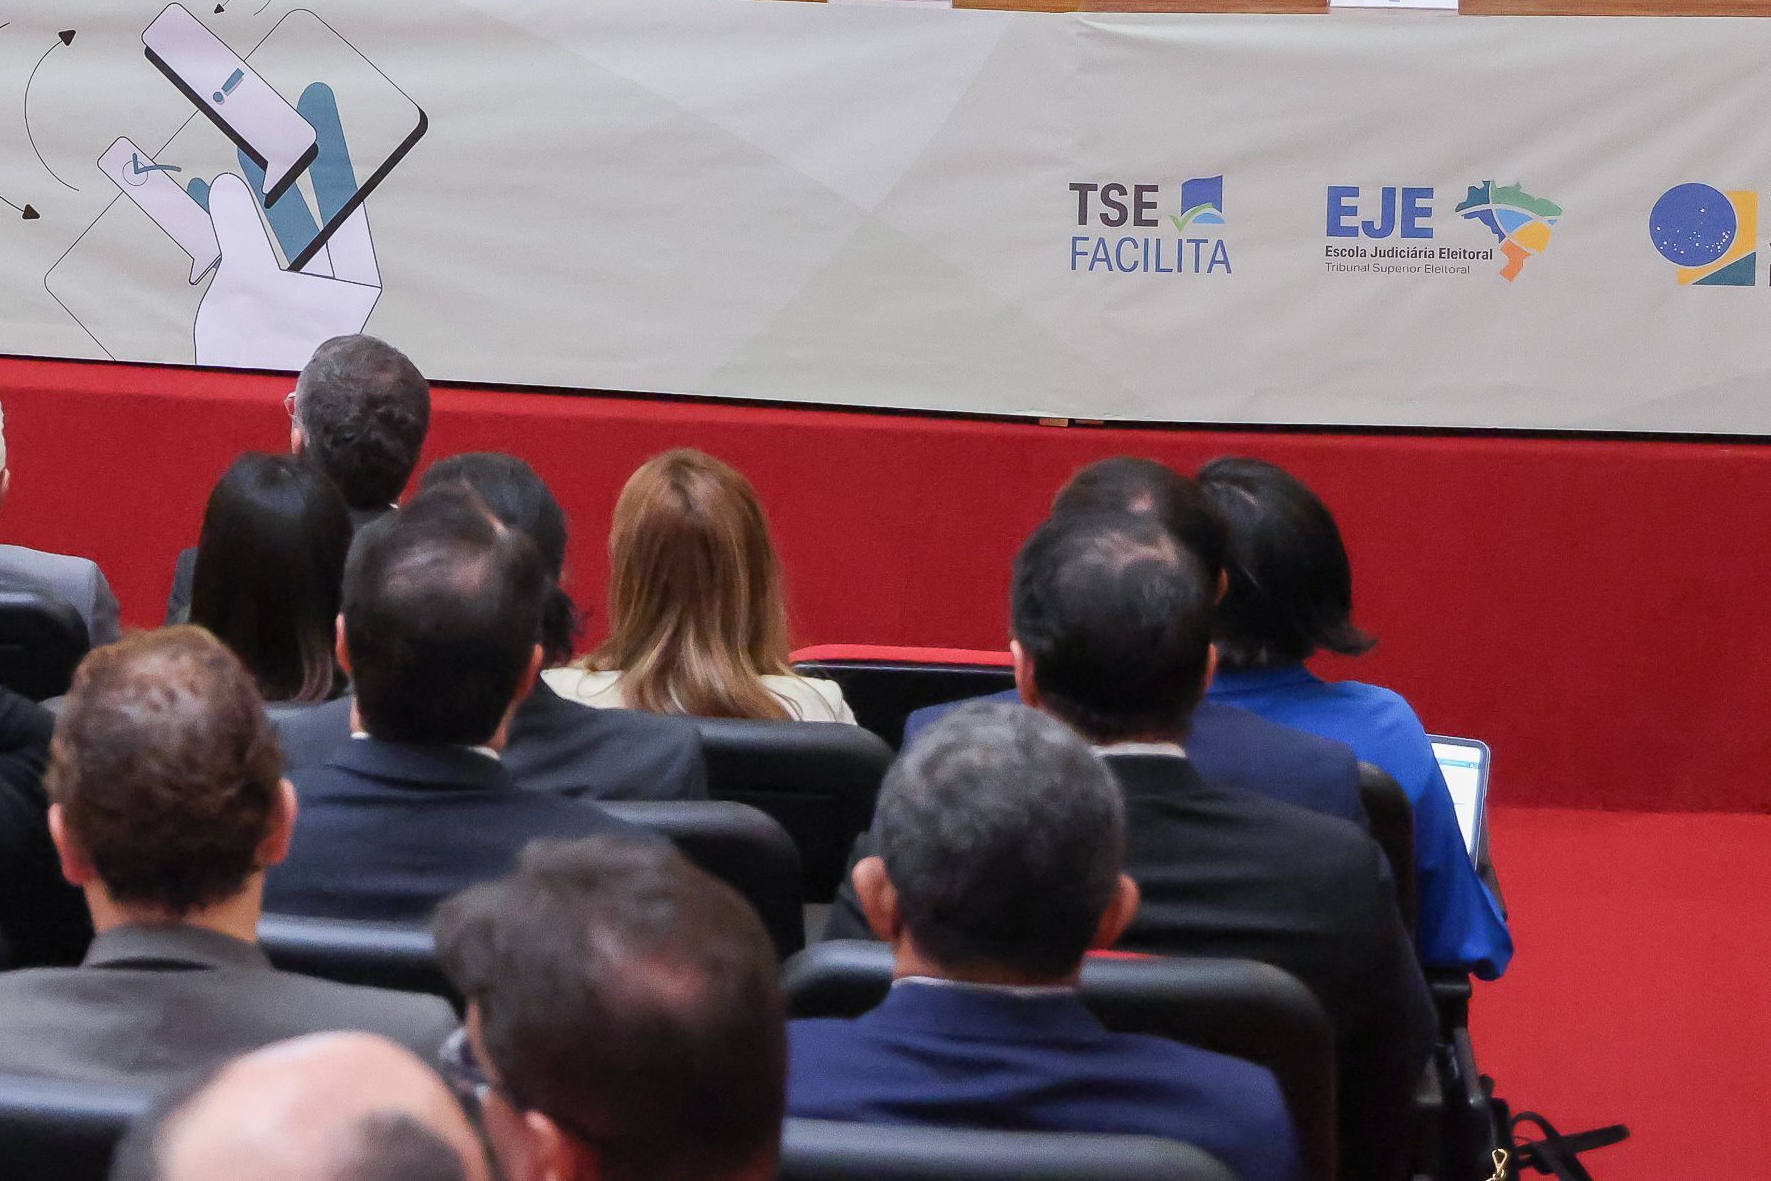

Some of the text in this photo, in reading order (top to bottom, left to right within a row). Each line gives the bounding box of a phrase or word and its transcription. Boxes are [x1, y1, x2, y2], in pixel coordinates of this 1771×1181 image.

[1069, 183, 1158, 227] TSE
[1326, 186, 1433, 238] EJE
[1071, 237, 1232, 273] FACILITA
[1325, 246, 1493, 260] Escola Judiciária Eleitoral
[1325, 263, 1470, 274] Tribunal Superior Eleitoral
